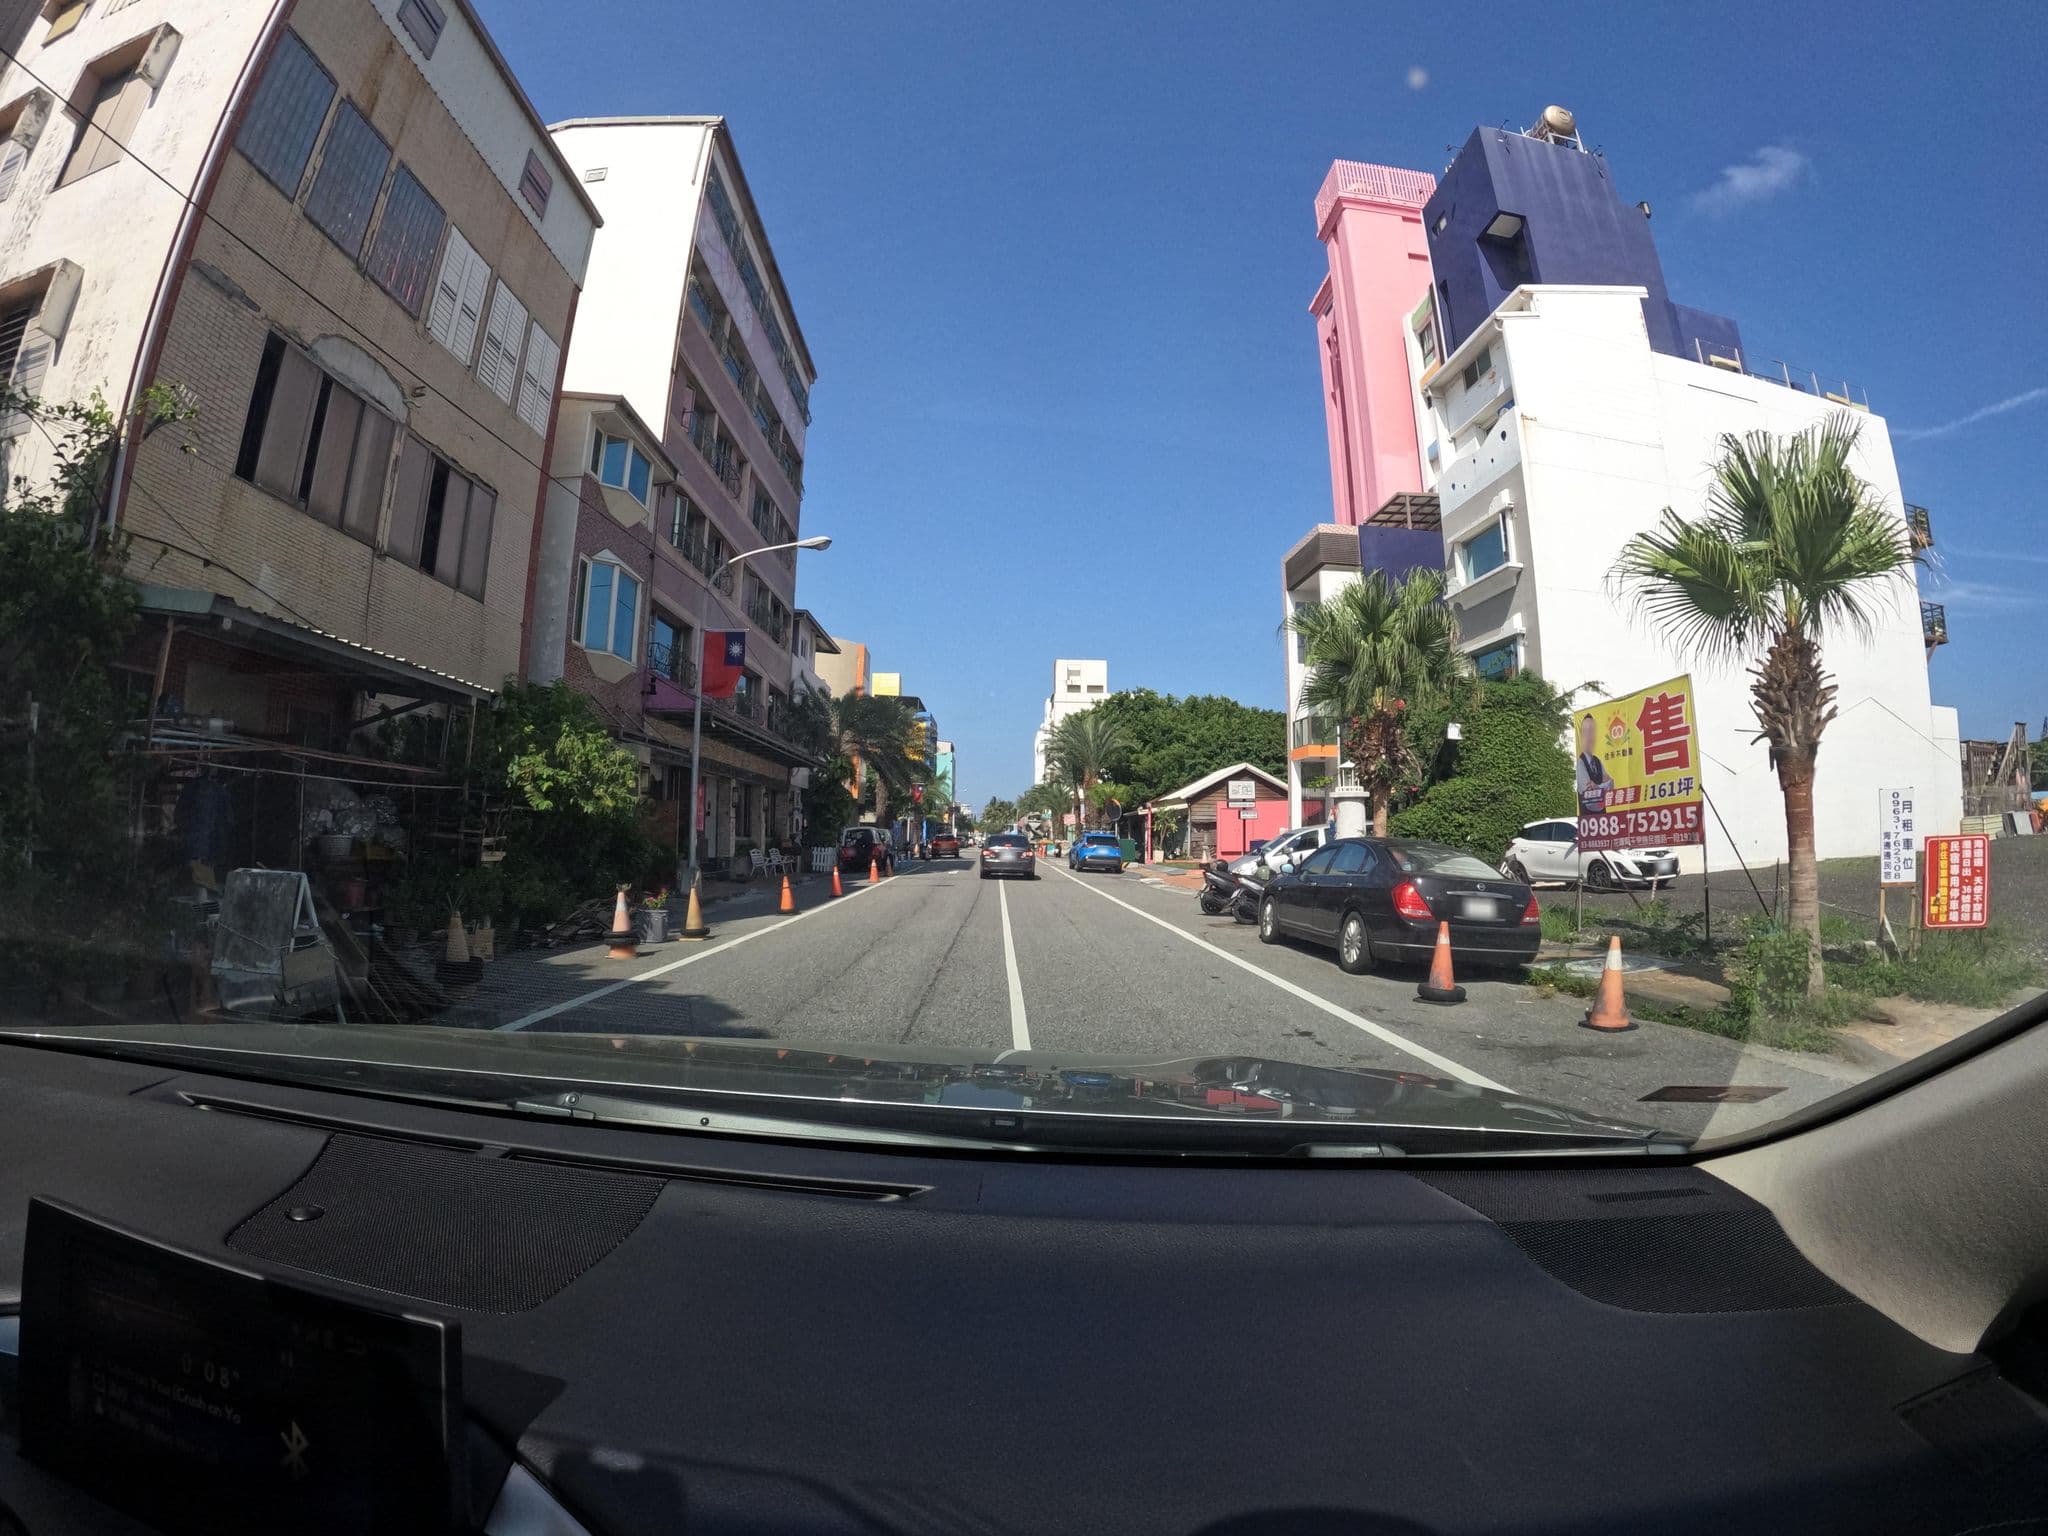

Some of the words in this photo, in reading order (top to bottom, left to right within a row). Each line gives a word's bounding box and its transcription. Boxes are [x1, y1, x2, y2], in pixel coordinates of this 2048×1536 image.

[1636, 692, 1690, 775] 售
[1580, 806, 1698, 838] 0988-752915
[1649, 776, 1694, 800] 161坪
[1892, 791, 1901, 880] 0963-762308
[1902, 800, 1914, 870] 月租車位
